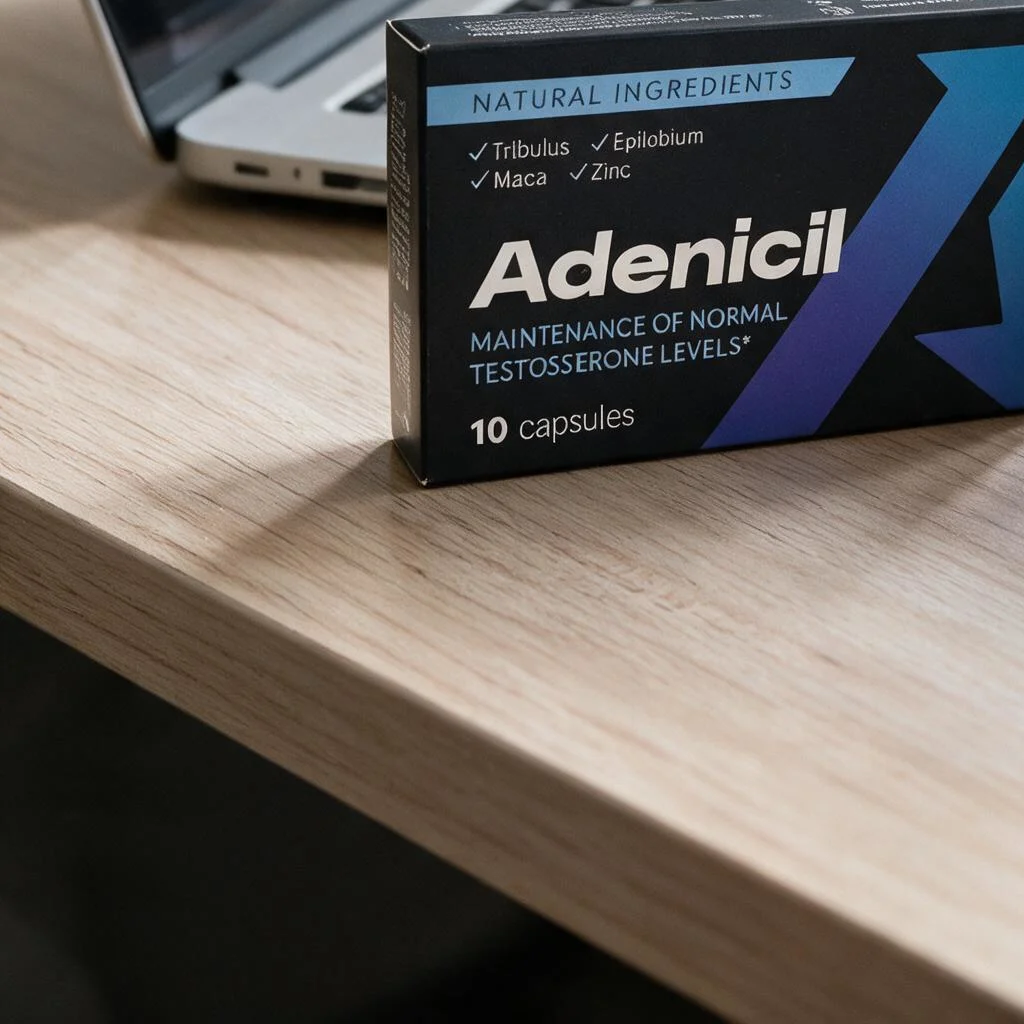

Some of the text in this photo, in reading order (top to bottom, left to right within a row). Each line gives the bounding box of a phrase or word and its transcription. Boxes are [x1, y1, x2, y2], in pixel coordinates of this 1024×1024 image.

[472, 69, 793, 114] NATURAL INGREDIENTS
[613, 127, 704, 153] Epilobium
[494, 161, 632, 189] Maca Zinc
[468, 207, 847, 309] Adenicil
[470, 302, 788, 353] MAINTENANCE OF NORMAL
[469, 345, 653, 385] TESTOSSERONE
[470, 404, 635, 445] 10 capsules
